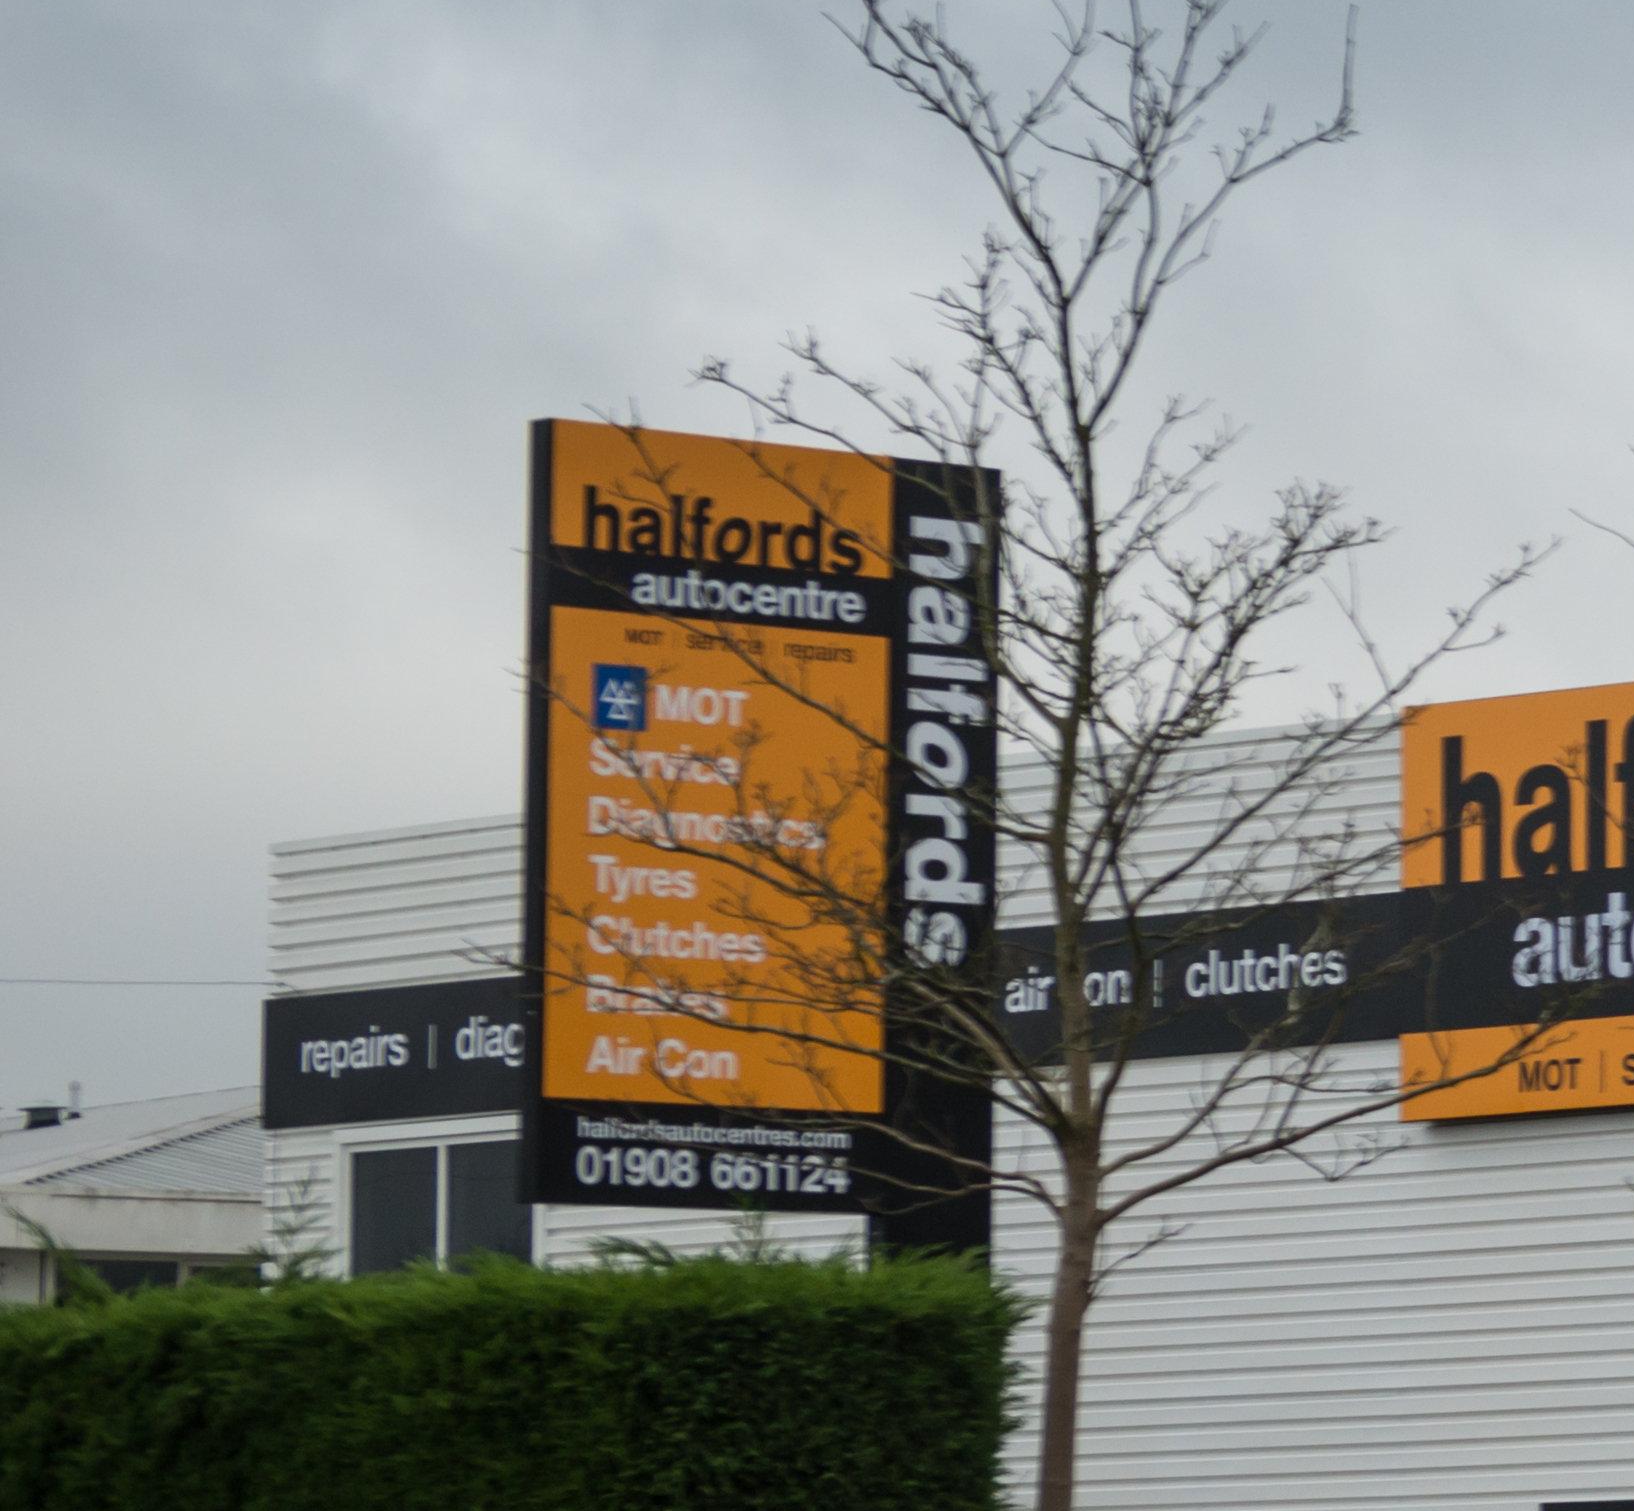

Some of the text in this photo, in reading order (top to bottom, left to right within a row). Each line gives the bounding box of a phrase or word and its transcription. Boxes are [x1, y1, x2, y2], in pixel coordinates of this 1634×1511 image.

[584, 485, 864, 577] halfords
[631, 569, 867, 623] autocentre
[655, 684, 750, 727] MOT
[903, 515, 989, 969] halfords
[587, 854, 697, 903] Tyres
[586, 915, 768, 963] Clutches
[1004, 966, 1055, 1014] air
[1185, 943, 1348, 998] clutches
[301, 1025, 411, 1078] repairs
[585, 1035, 741, 1080] Air Con
[1517, 1057, 1582, 1093] MOT
[575, 1144, 852, 1194] 01908 661124
